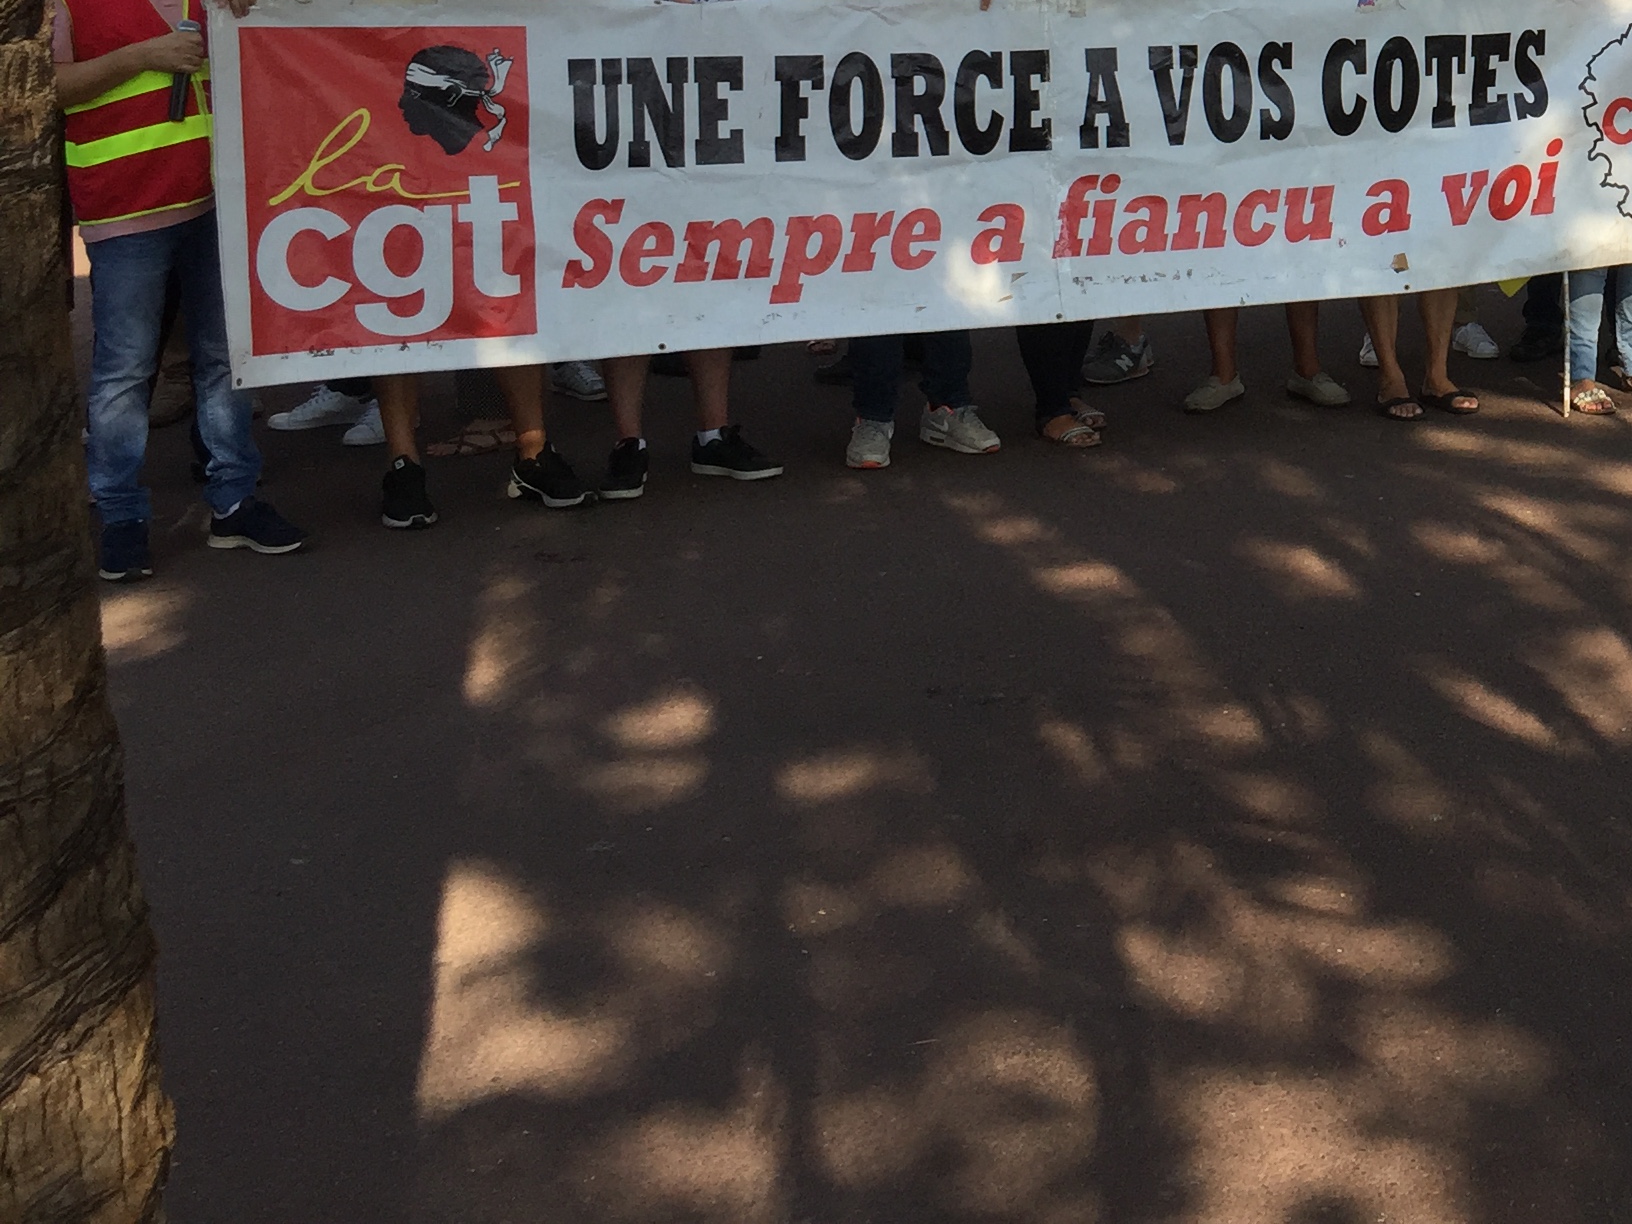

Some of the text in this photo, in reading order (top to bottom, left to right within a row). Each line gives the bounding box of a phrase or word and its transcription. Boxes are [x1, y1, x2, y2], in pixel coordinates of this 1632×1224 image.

[268, 108, 470, 205] la
[567, 28, 1549, 171] UNE FORCE A VOS COTES
[256, 175, 522, 337] cgt
[561, 138, 1564, 305] Sempre a fiancu a voi
